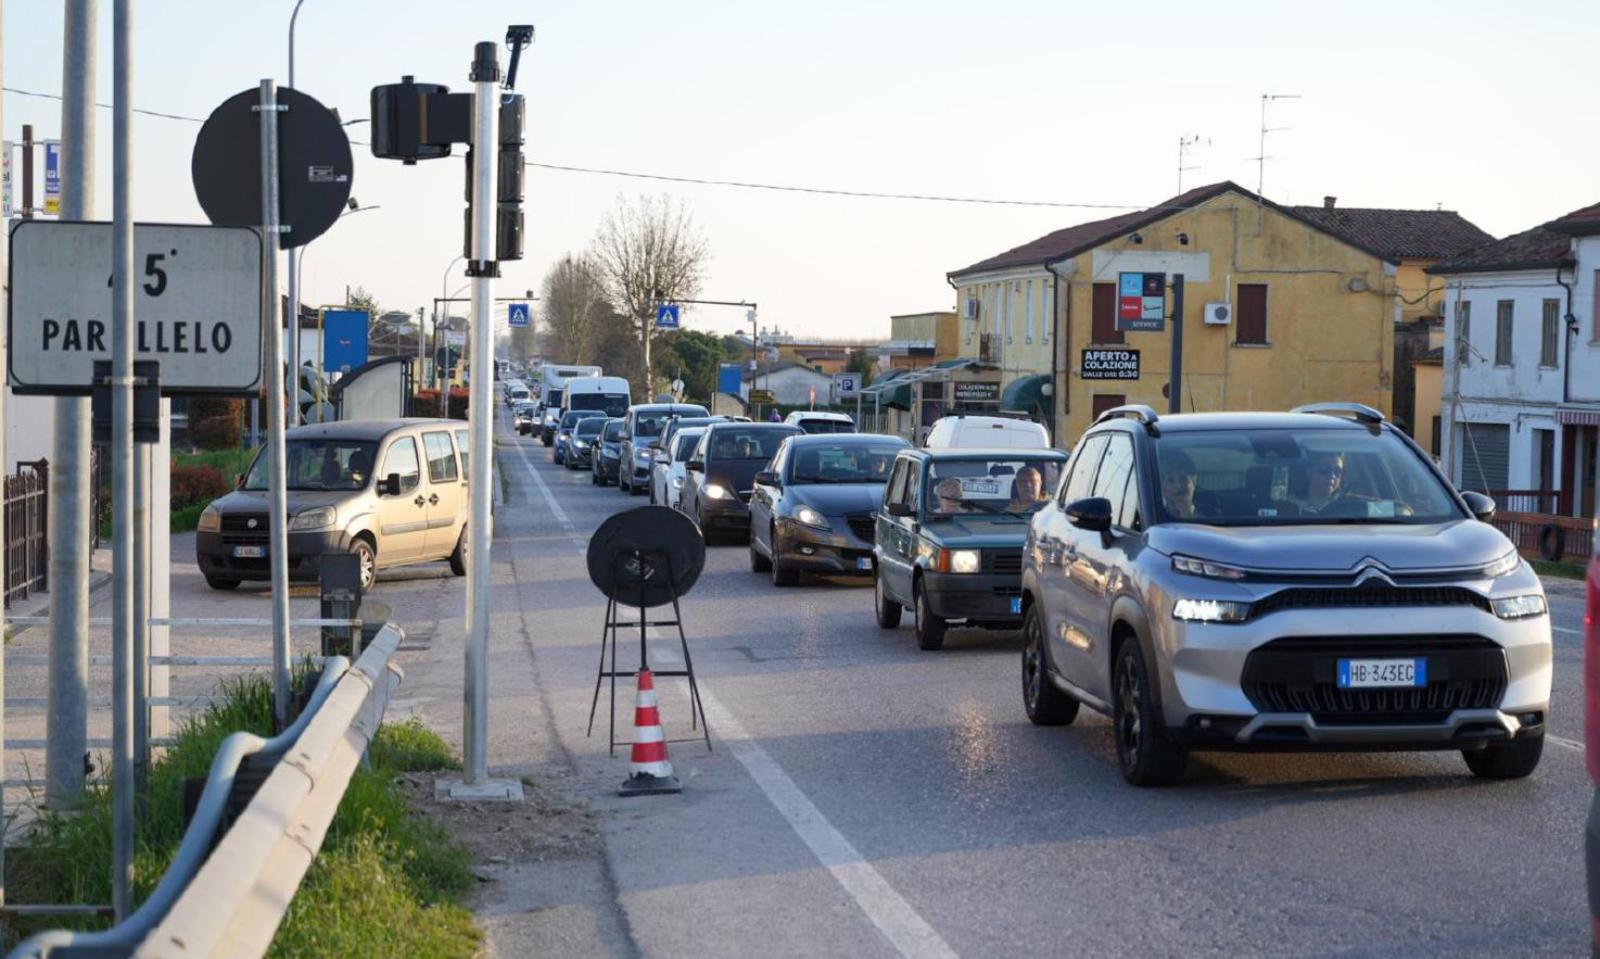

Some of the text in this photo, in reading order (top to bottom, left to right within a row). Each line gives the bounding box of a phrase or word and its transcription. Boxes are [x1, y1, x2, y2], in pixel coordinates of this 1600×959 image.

[108, 248, 178, 298] 5°
[42, 319, 232, 354] PARLLELO
[1084, 361, 1137, 370] COLAZIONE
[1085, 351, 1129, 361] APERTO
